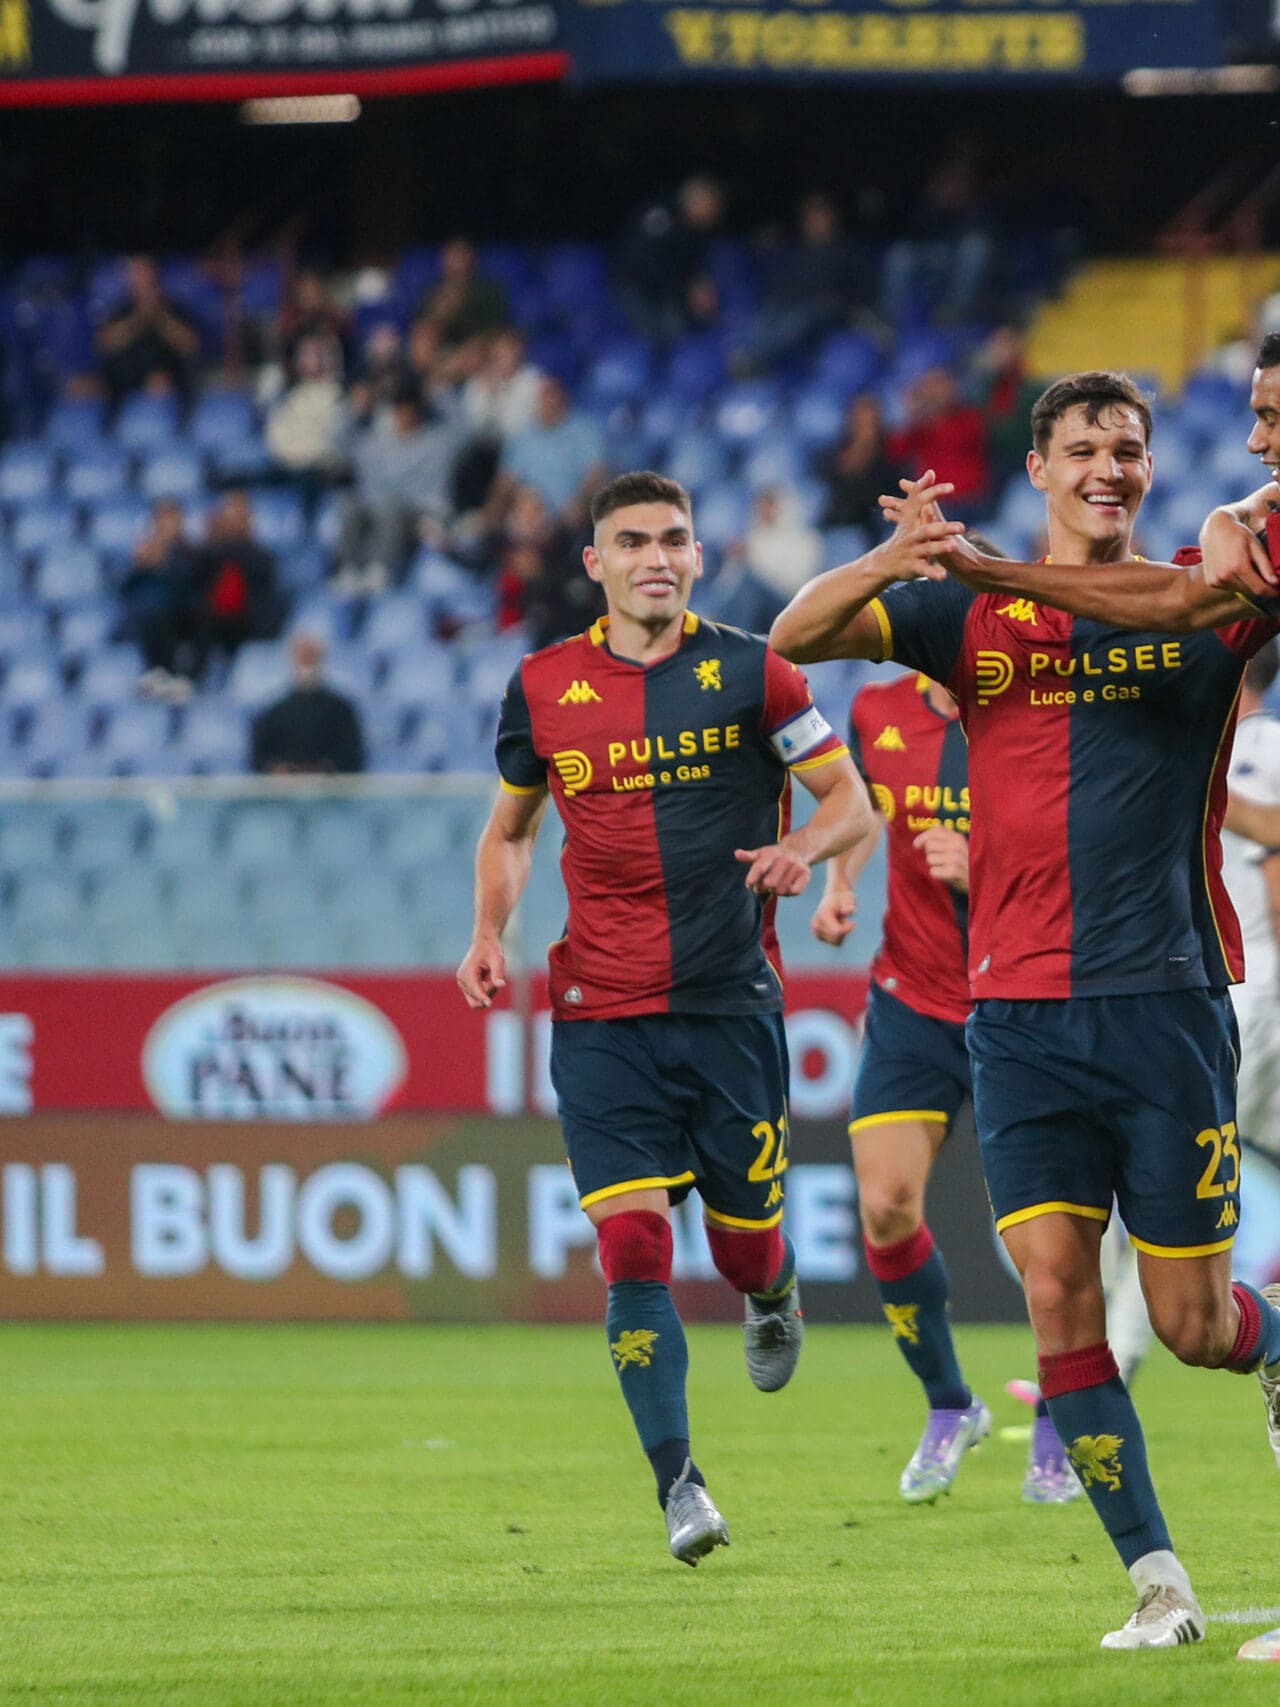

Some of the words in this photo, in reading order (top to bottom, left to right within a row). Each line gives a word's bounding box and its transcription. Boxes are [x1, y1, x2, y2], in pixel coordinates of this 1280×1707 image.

[1030, 641, 1183, 679] PULSEE
[1029, 688, 1077, 707] Luce
[1083, 690, 1094, 702] e
[1102, 684, 1141, 702] Gas
[608, 723, 741, 767] PULSEE
[611, 773, 655, 794] Luce
[660, 769, 671, 786] e
[676, 763, 711, 782] Gas
[186, 1045, 358, 1104] PANE
[1195, 1120, 1240, 1199] 23
[3, 1163, 104, 1276] IL
[130, 1163, 498, 1281] BUON
